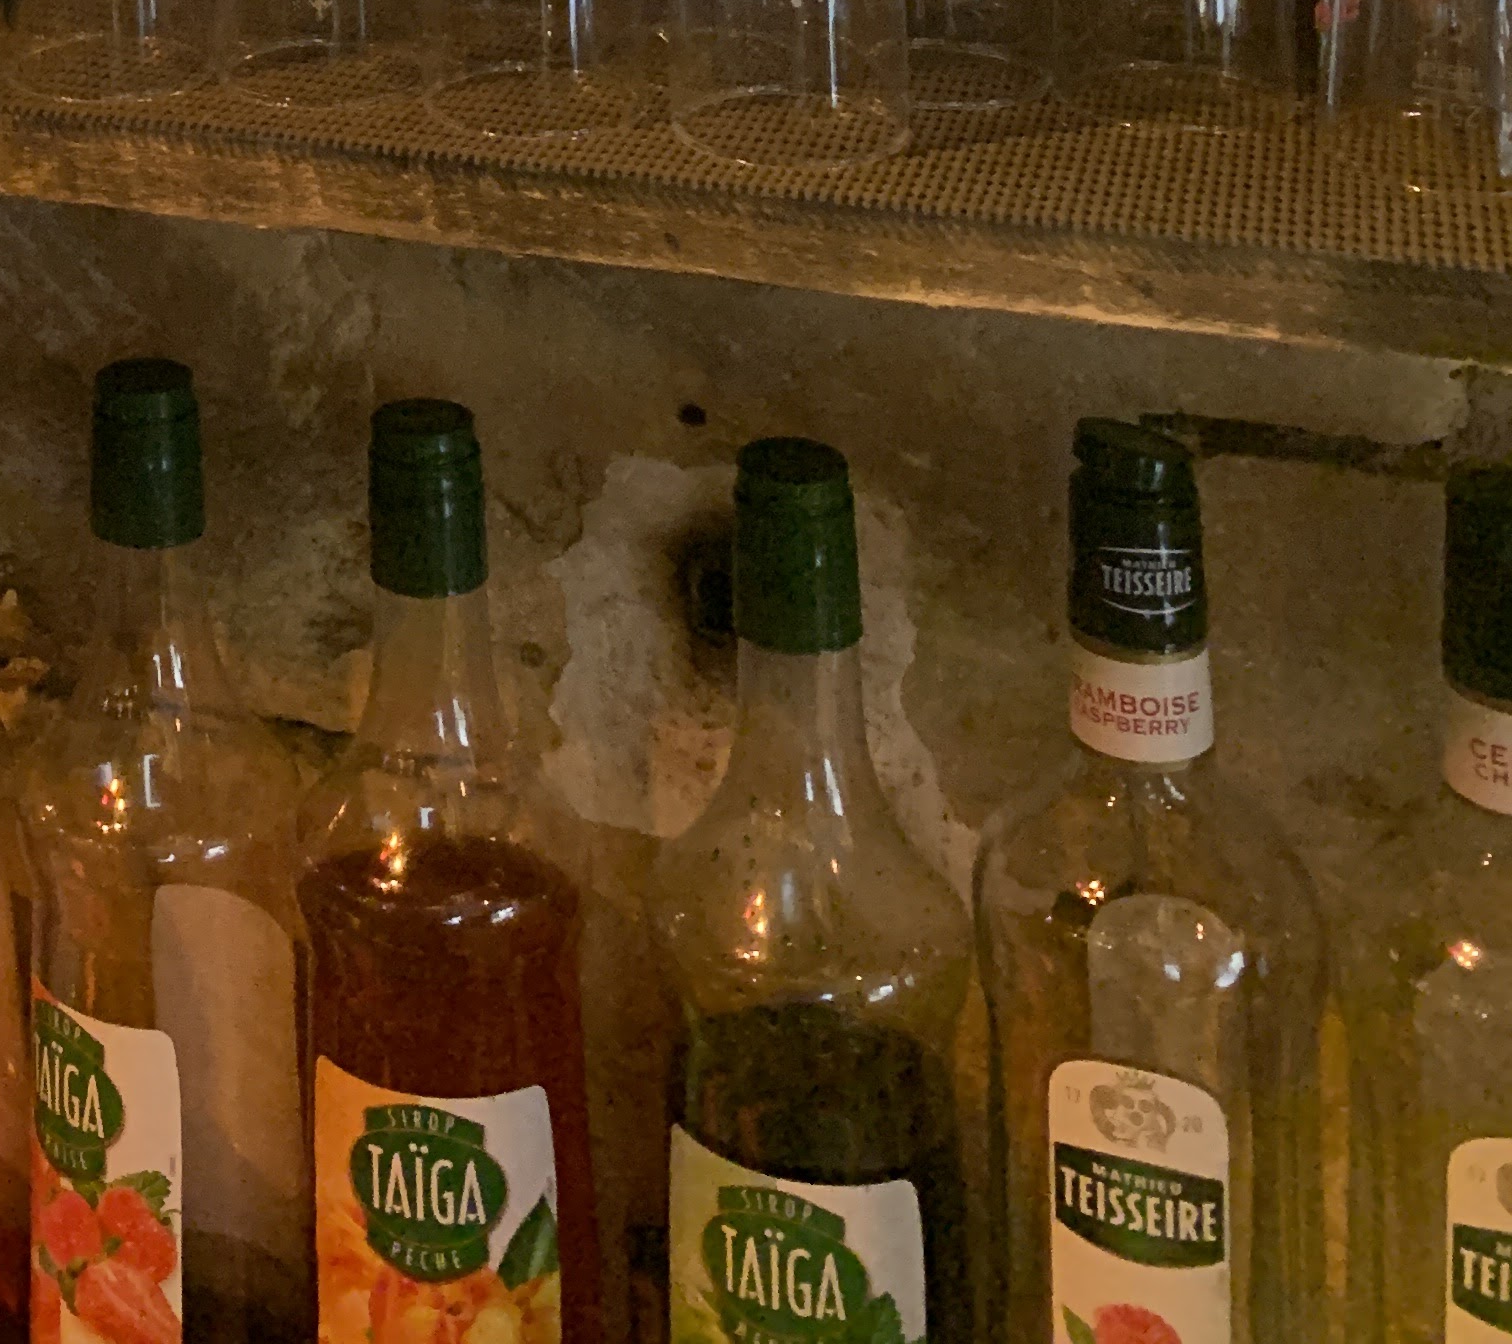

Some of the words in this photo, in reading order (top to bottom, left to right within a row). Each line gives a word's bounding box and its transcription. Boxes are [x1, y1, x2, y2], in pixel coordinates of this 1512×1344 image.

[1101, 562, 1192, 598] TEISSEIRE
[1073, 672, 1201, 717] RAMBOISE
[387, 1108, 456, 1135] SIROP
[367, 1142, 487, 1226] TAÏGA
[739, 1188, 814, 1221] SIROP
[1059, 1163, 1217, 1243] TEISSEIRE
[720, 1224, 847, 1322] TAÏGA
